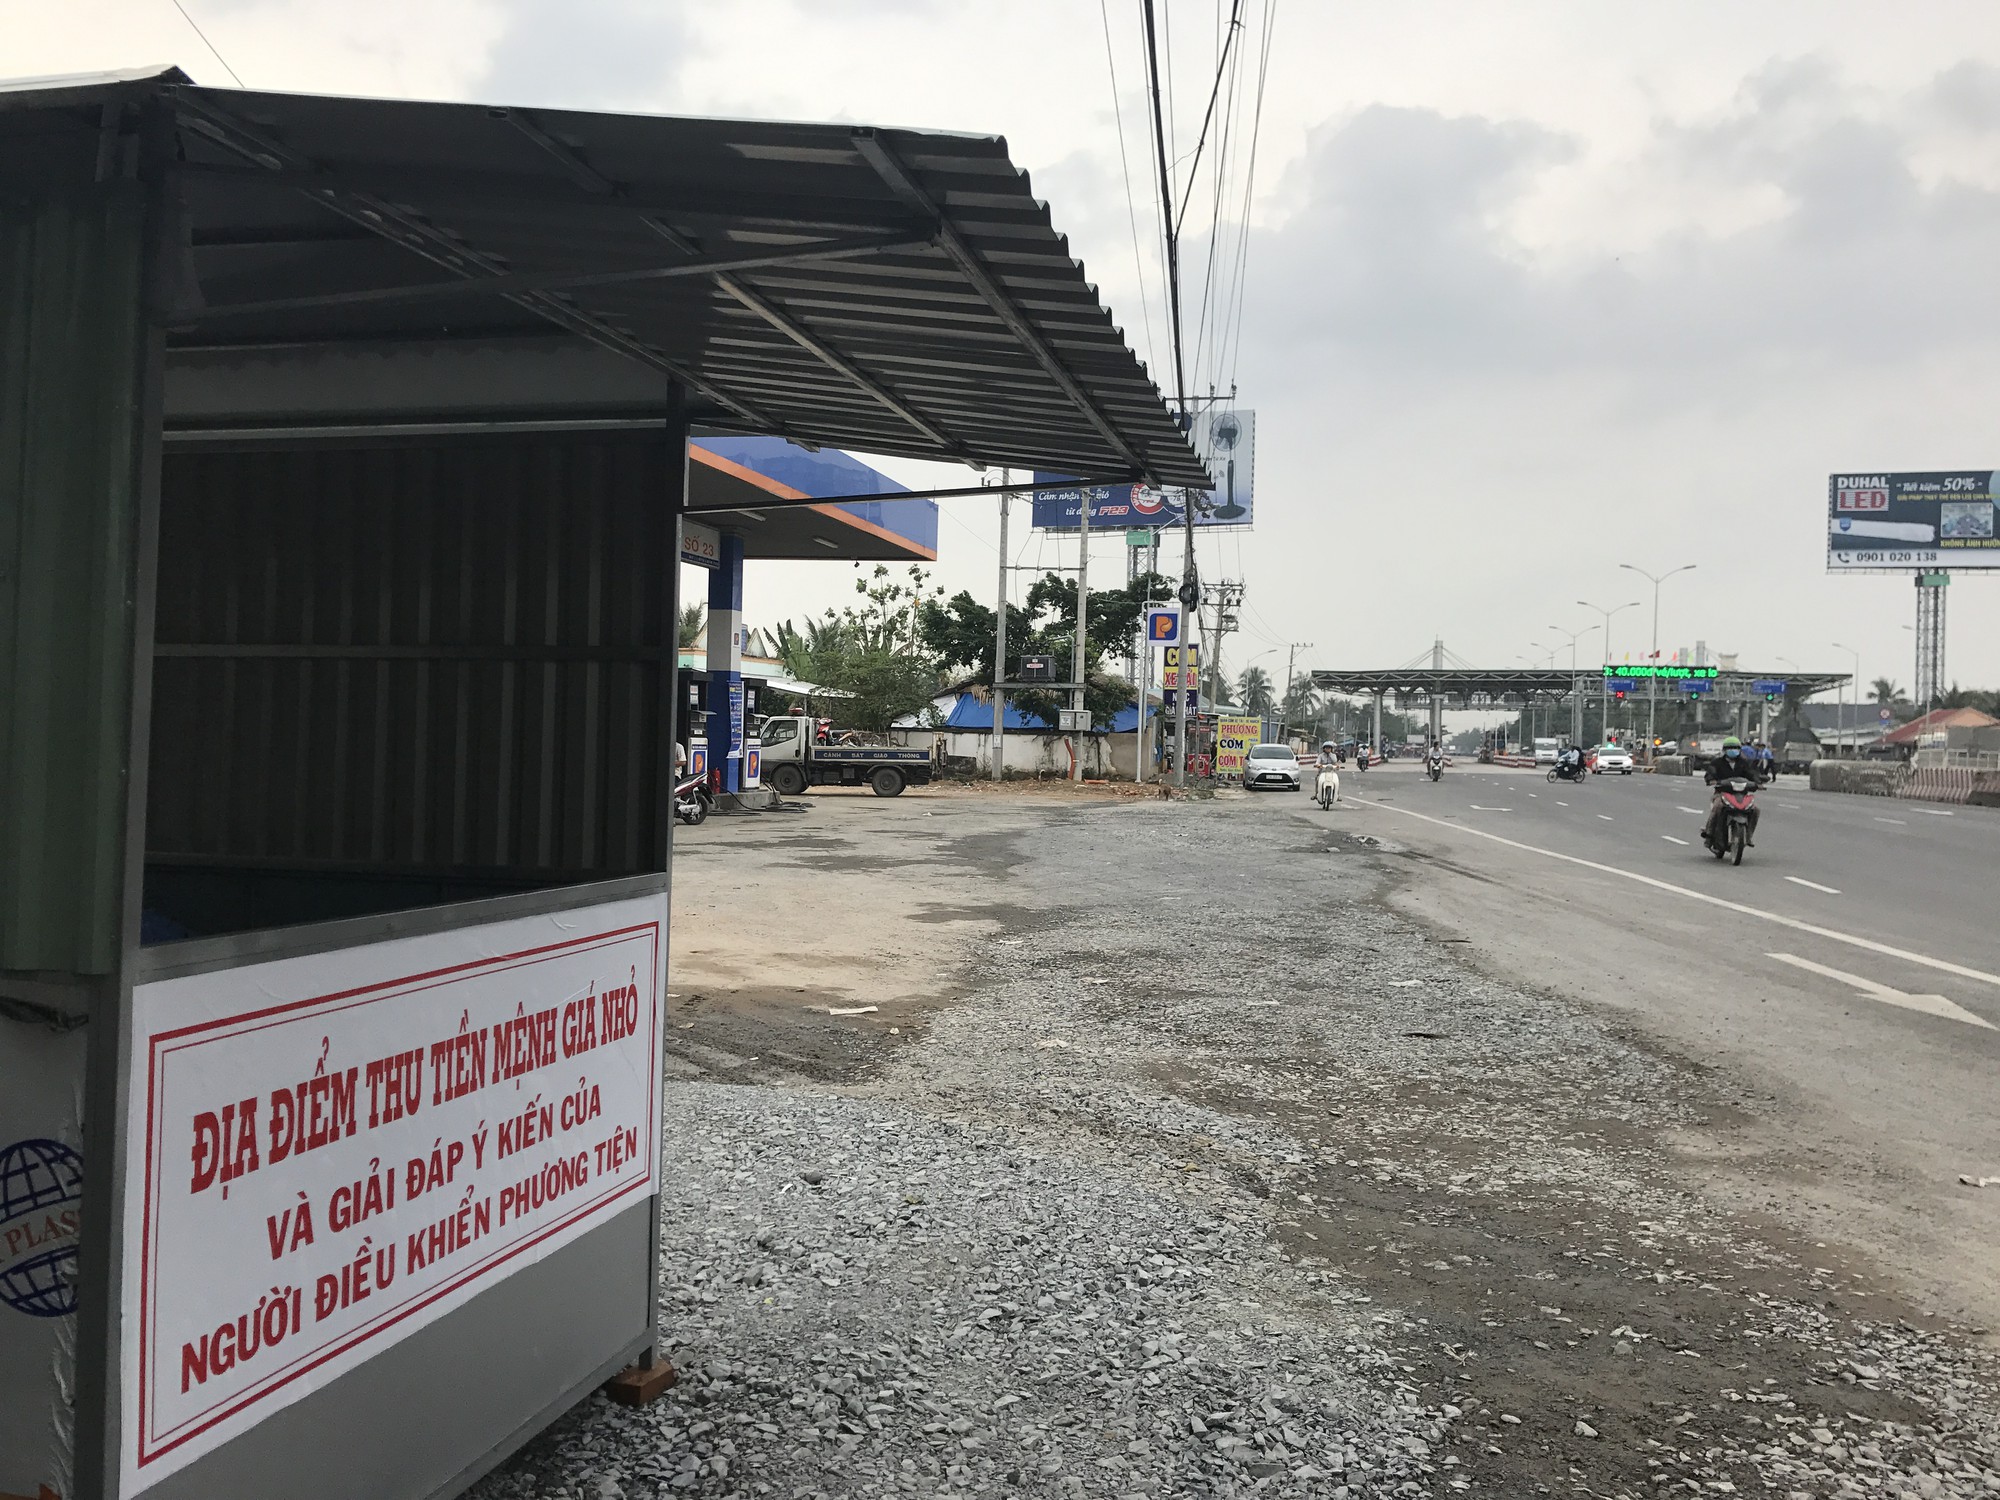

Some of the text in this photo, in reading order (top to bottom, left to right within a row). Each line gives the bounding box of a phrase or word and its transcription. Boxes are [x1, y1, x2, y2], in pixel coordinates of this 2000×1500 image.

[1837, 476, 1890, 489] DUHAL
[1942, 477, 1976, 491] 50%
[1839, 491, 1886, 509] LED
[1098, 506, 1129, 515] F23
[684, 535, 714, 556] SỐ 23
[1857, 552, 1937, 561] 0901 020 138
[1167, 648, 1198, 666] CM
[1219, 738, 1244, 749] CƠM
[1218, 754, 1237, 767] CƠM
[191, 964, 638, 1200] ĐỊA ĐIỂM THU TIỀN MỆNH GIÁ NHỎ
[267, 1076, 602, 1260] VÀ GIẢI ĐÁP Ý KIẾN CỦA
[181, 1125, 637, 1395] NGƯỜI ĐIỀU KHIỂN PHƯƠNG TIỆN
